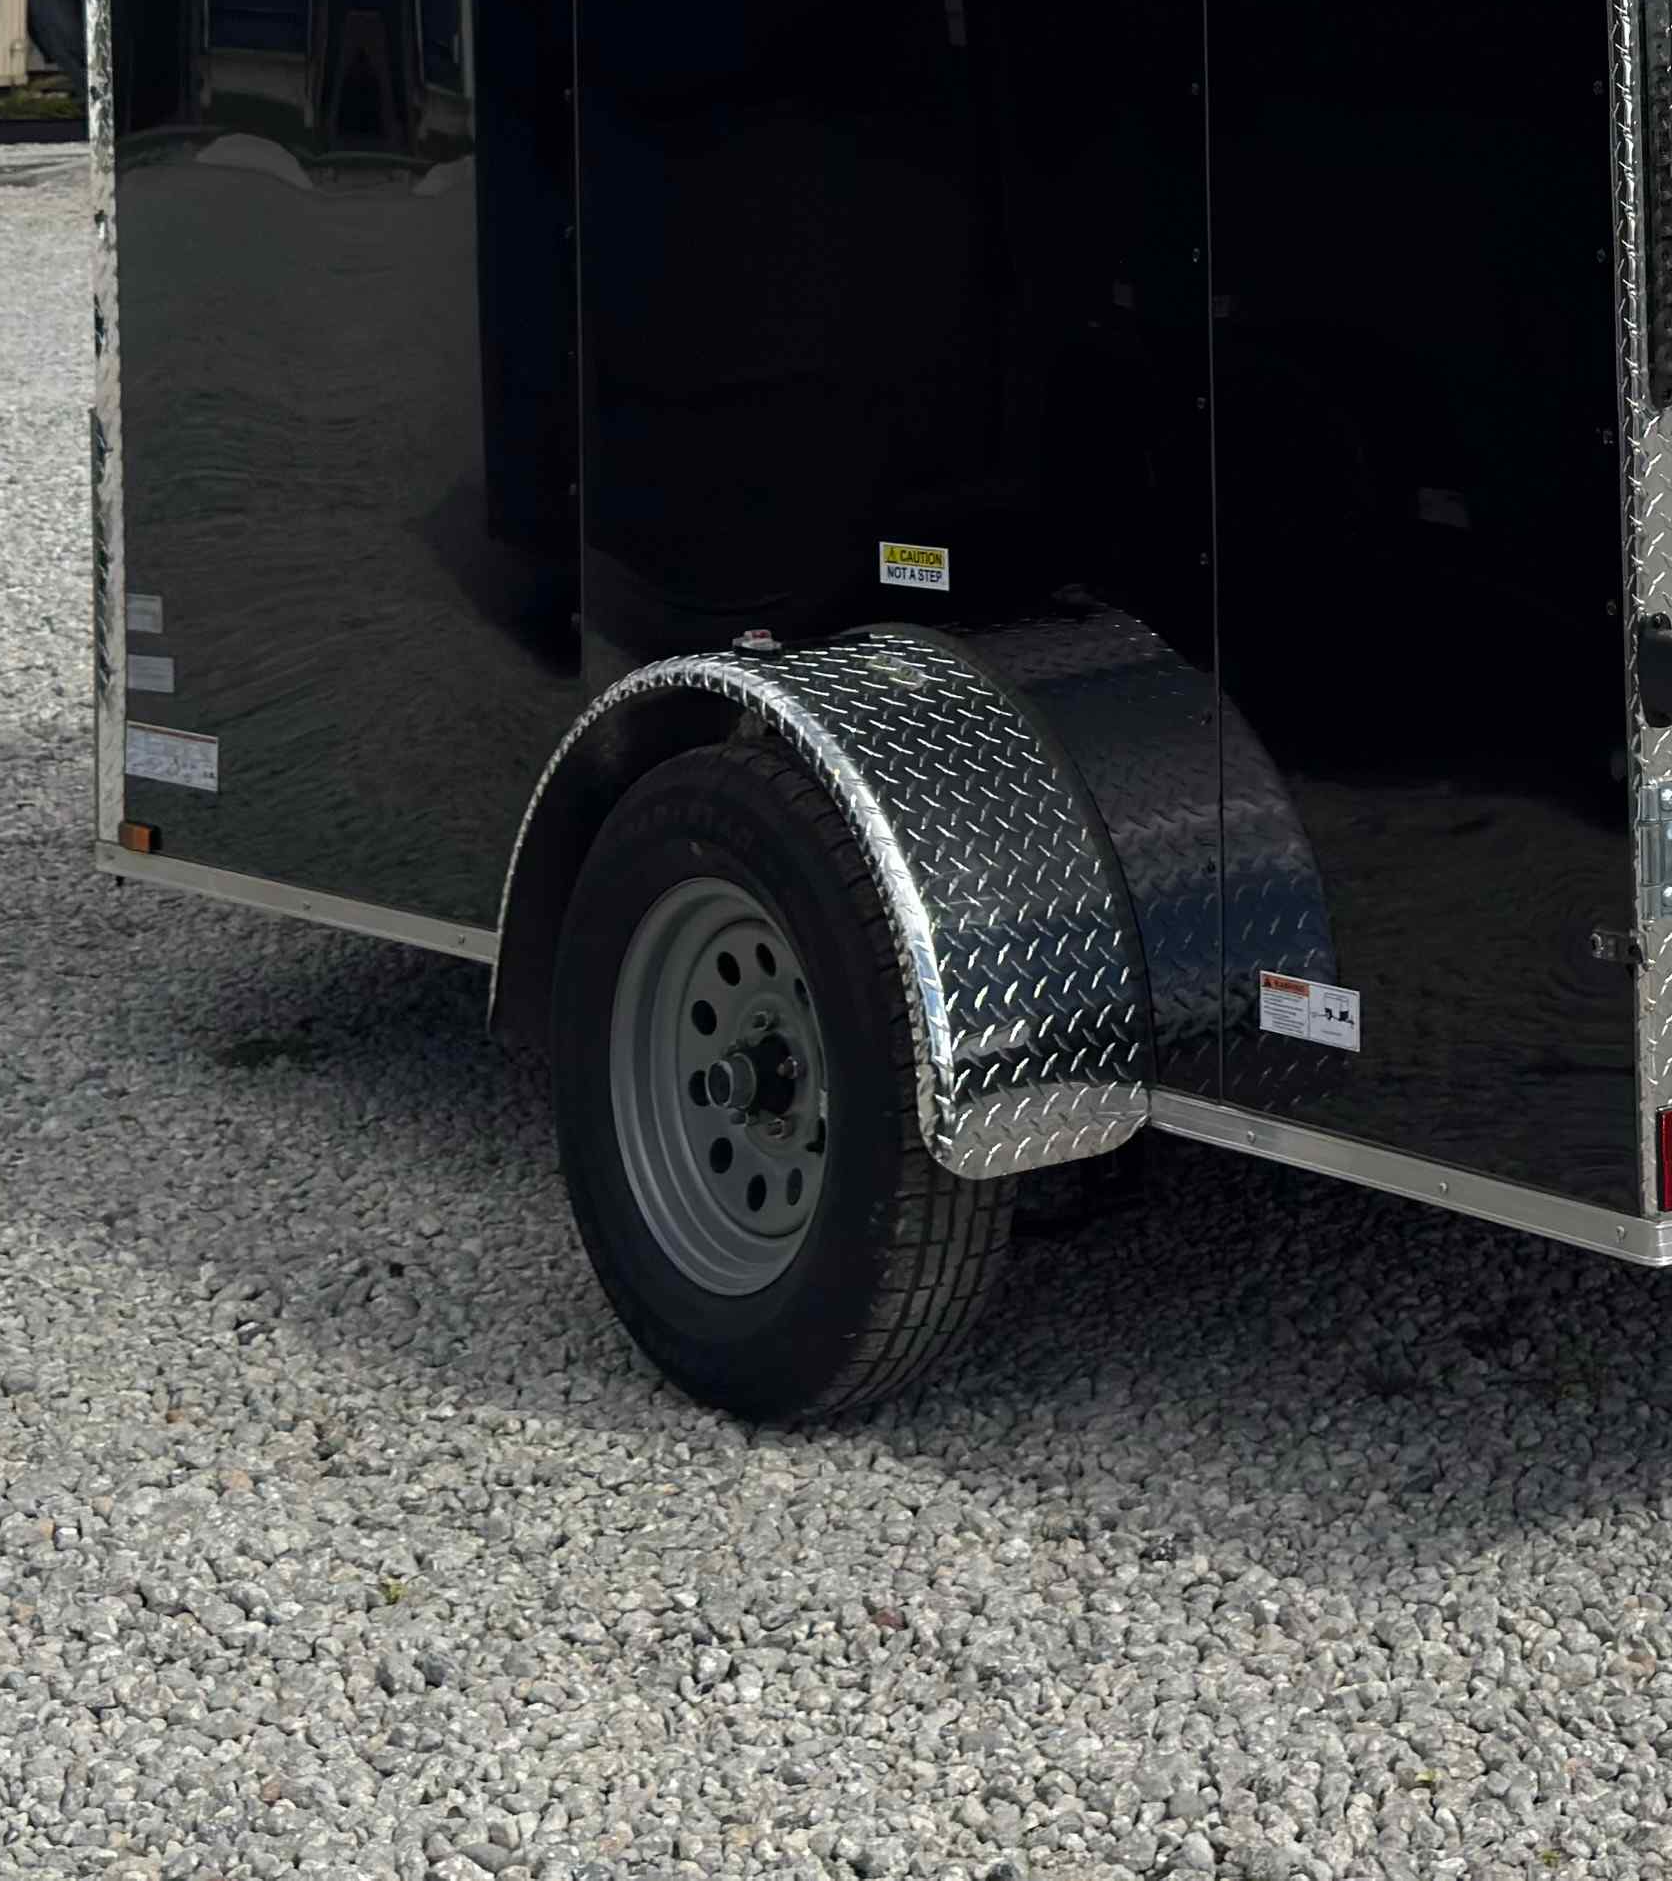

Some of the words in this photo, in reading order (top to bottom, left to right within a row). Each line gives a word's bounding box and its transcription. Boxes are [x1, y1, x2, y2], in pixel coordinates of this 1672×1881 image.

[899, 549, 943, 566] CAUTION
[888, 566, 907, 579] NOT
[909, 568, 916, 580] A
[918, 569, 942, 583] STEP
